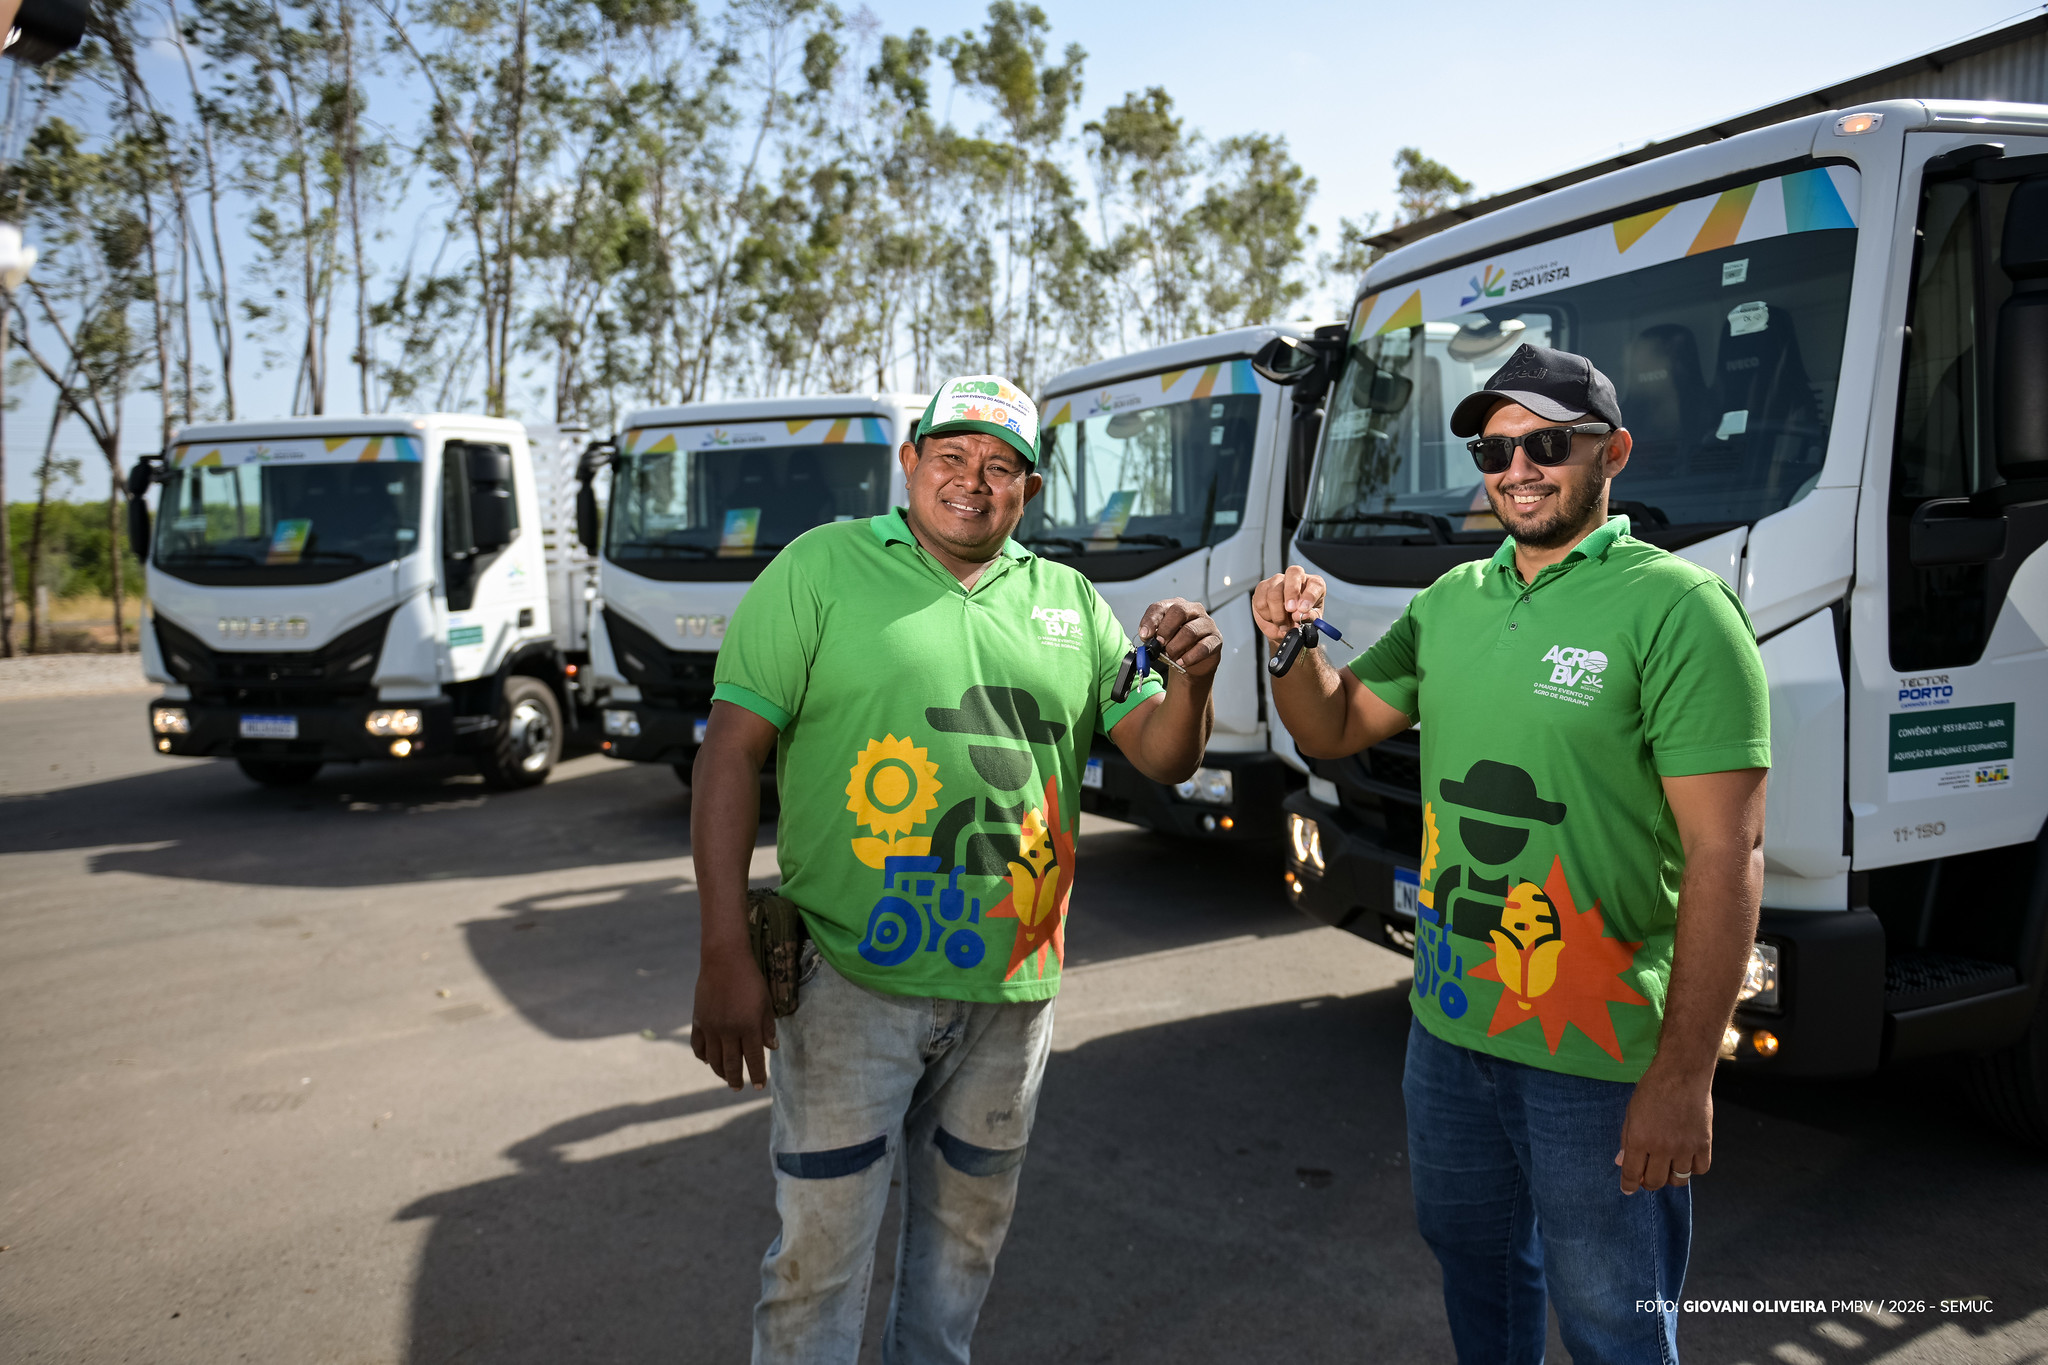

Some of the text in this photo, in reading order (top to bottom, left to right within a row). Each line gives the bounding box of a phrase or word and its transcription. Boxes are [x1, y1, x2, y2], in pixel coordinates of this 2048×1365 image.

[1510, 266, 1570, 292] BOA VISTA
[1030, 605, 1080, 625] AGRO
[675, 613, 727, 639] IVE
[1045, 621, 1069, 637] BV
[1541, 645, 1608, 673] AGRO
[1549, 664, 1586, 687] BV
[1900, 674, 1950, 689] TECTOR
[1533, 689, 1549, 697] AGRO
[1559, 694, 1590, 707] RORAIMA
[1538, 682, 1558, 692] MAIOR
[1558, 688, 1583, 698] EVENTO
[1898, 685, 1953, 701] PORTO
[1897, 725, 1931, 738] CONVÊNIO
[1894, 749, 1924, 761] AQUISIÇÃO
[1924, 748, 1933, 757] DE
[1933, 745, 1963, 756] MÁQUINAS
[1967, 740, 2008, 753] EQUIPAMENTOS
